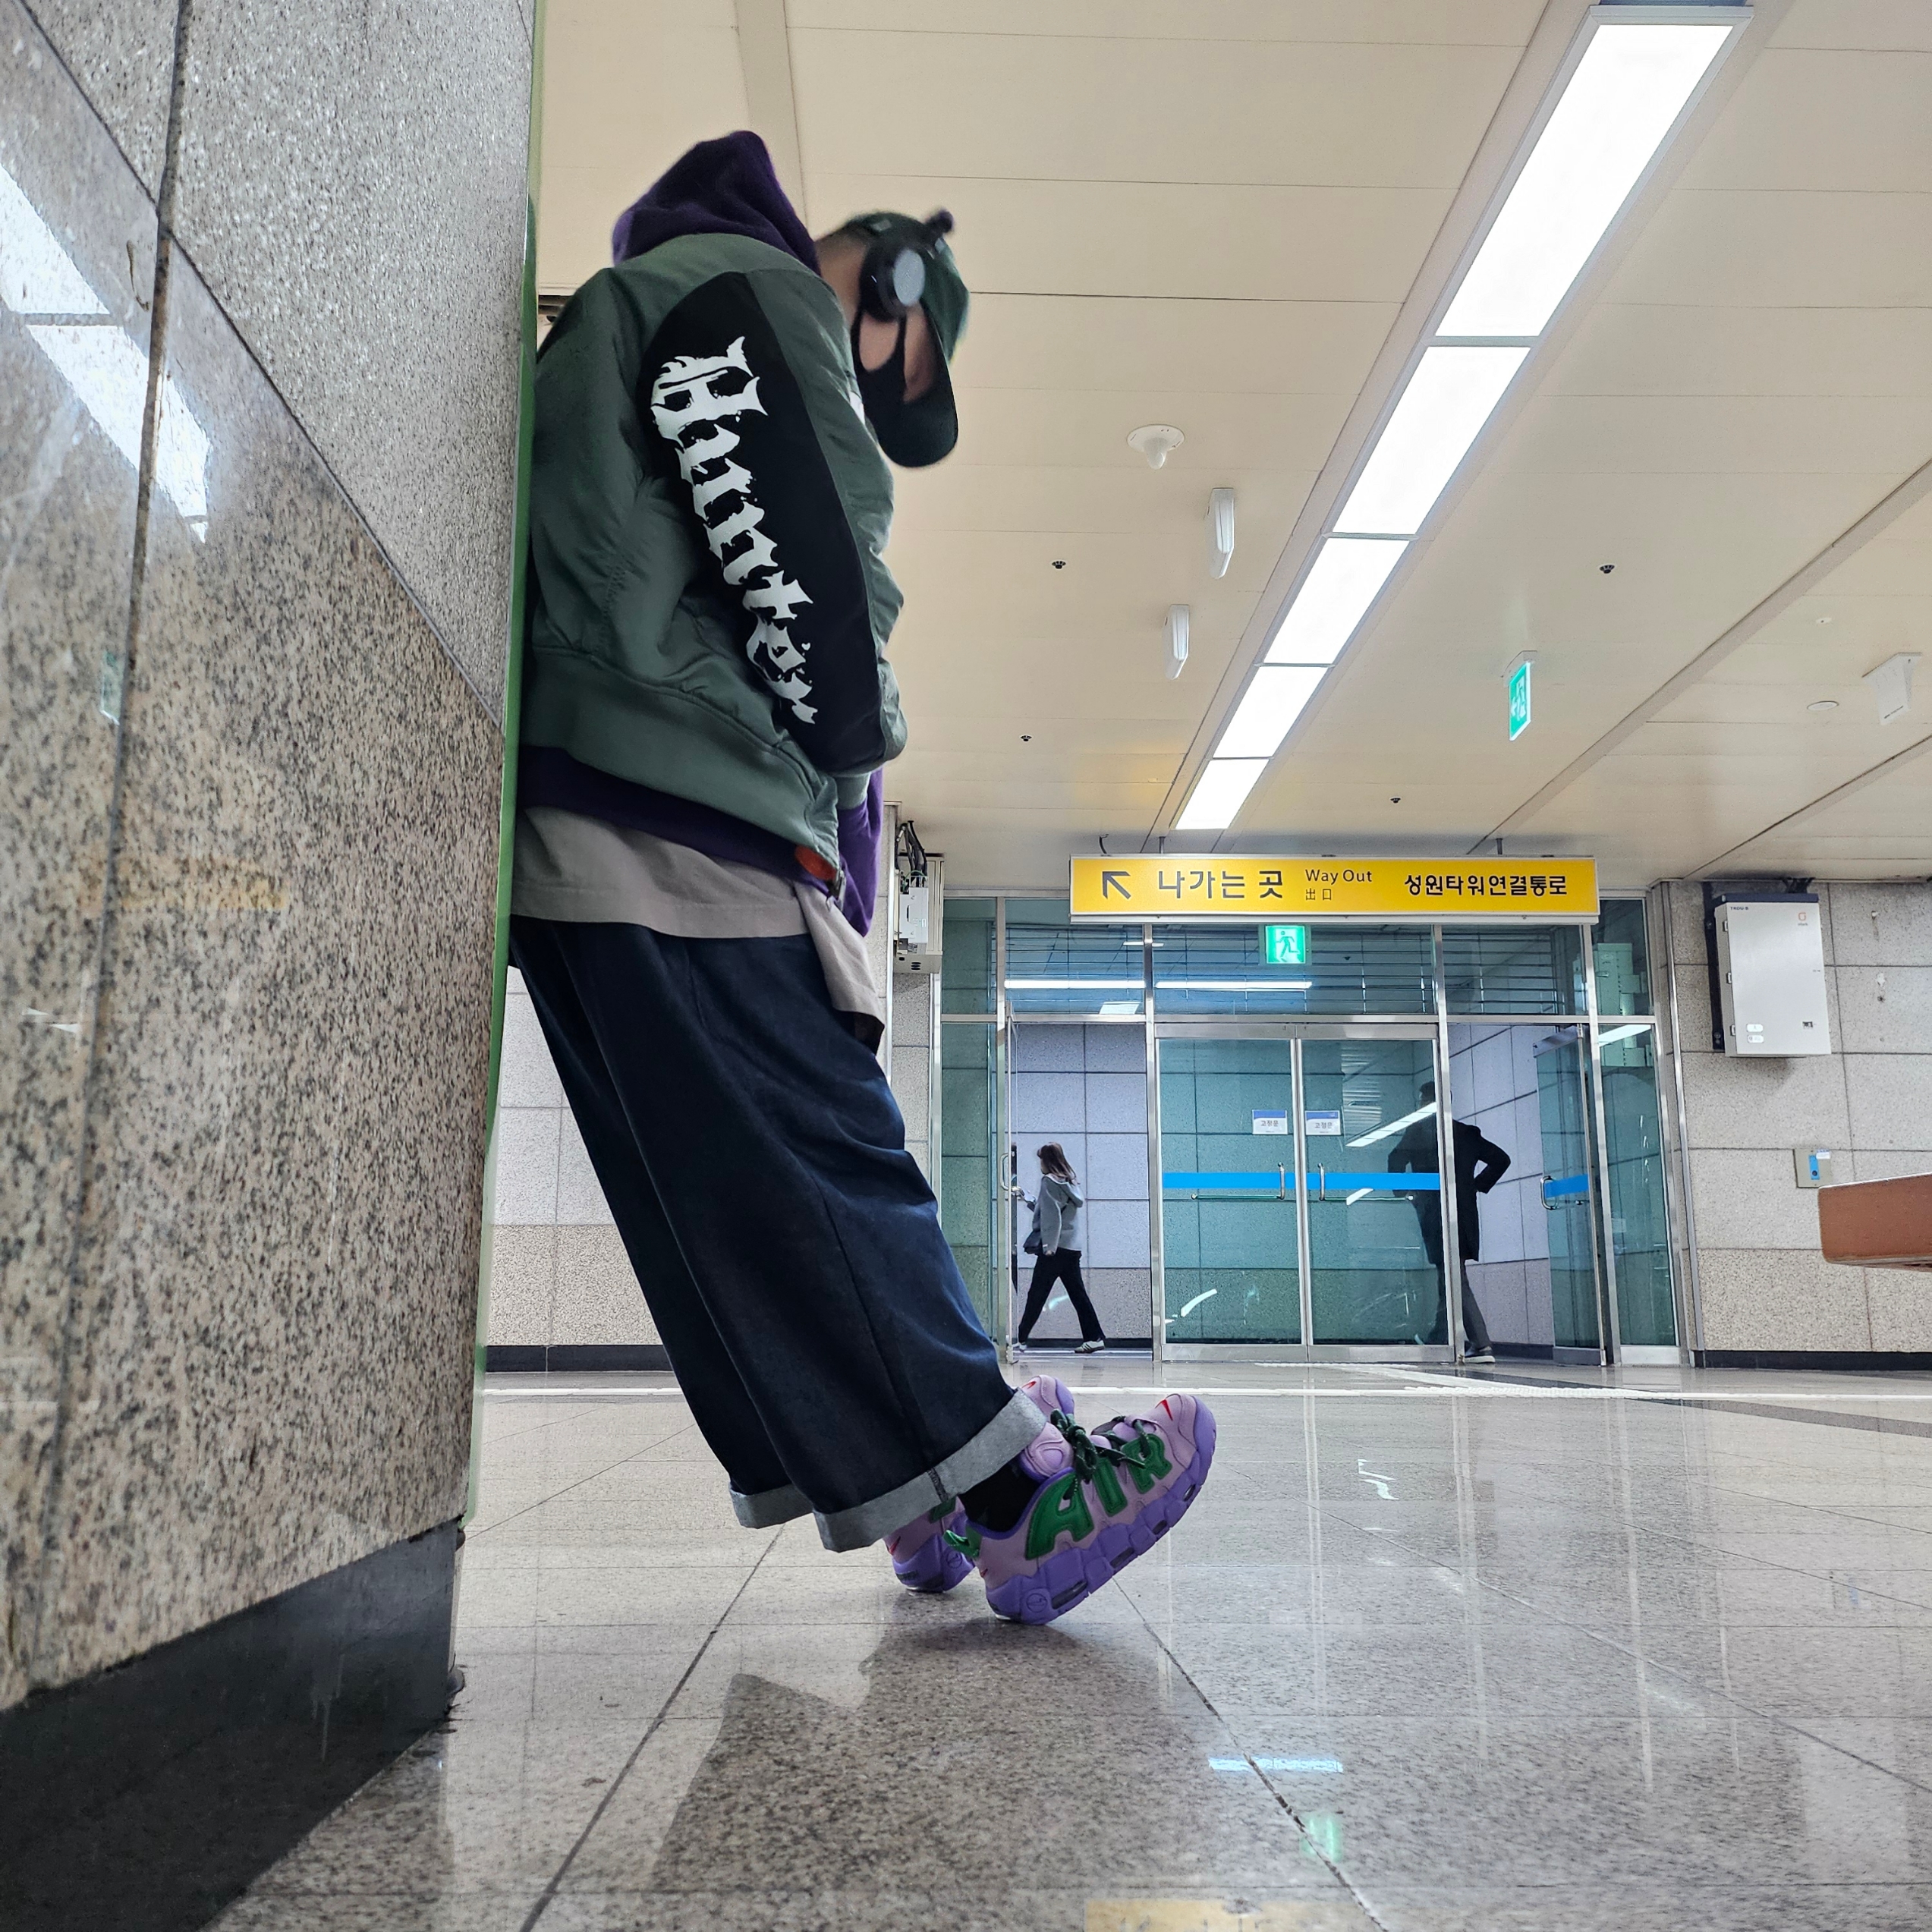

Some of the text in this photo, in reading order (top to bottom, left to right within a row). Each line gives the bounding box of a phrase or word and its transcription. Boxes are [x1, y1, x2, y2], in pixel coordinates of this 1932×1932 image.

[650, 335, 819, 725] Hunter
[1158, 870, 1283, 899] 나가는 곳
[1304, 869, 1373, 886] Way Out
[1404, 874, 1568, 896] 성원타워연결통로
[1305, 887, 1333, 901] 出口
[1026, 1433, 1173, 1561] AIR
